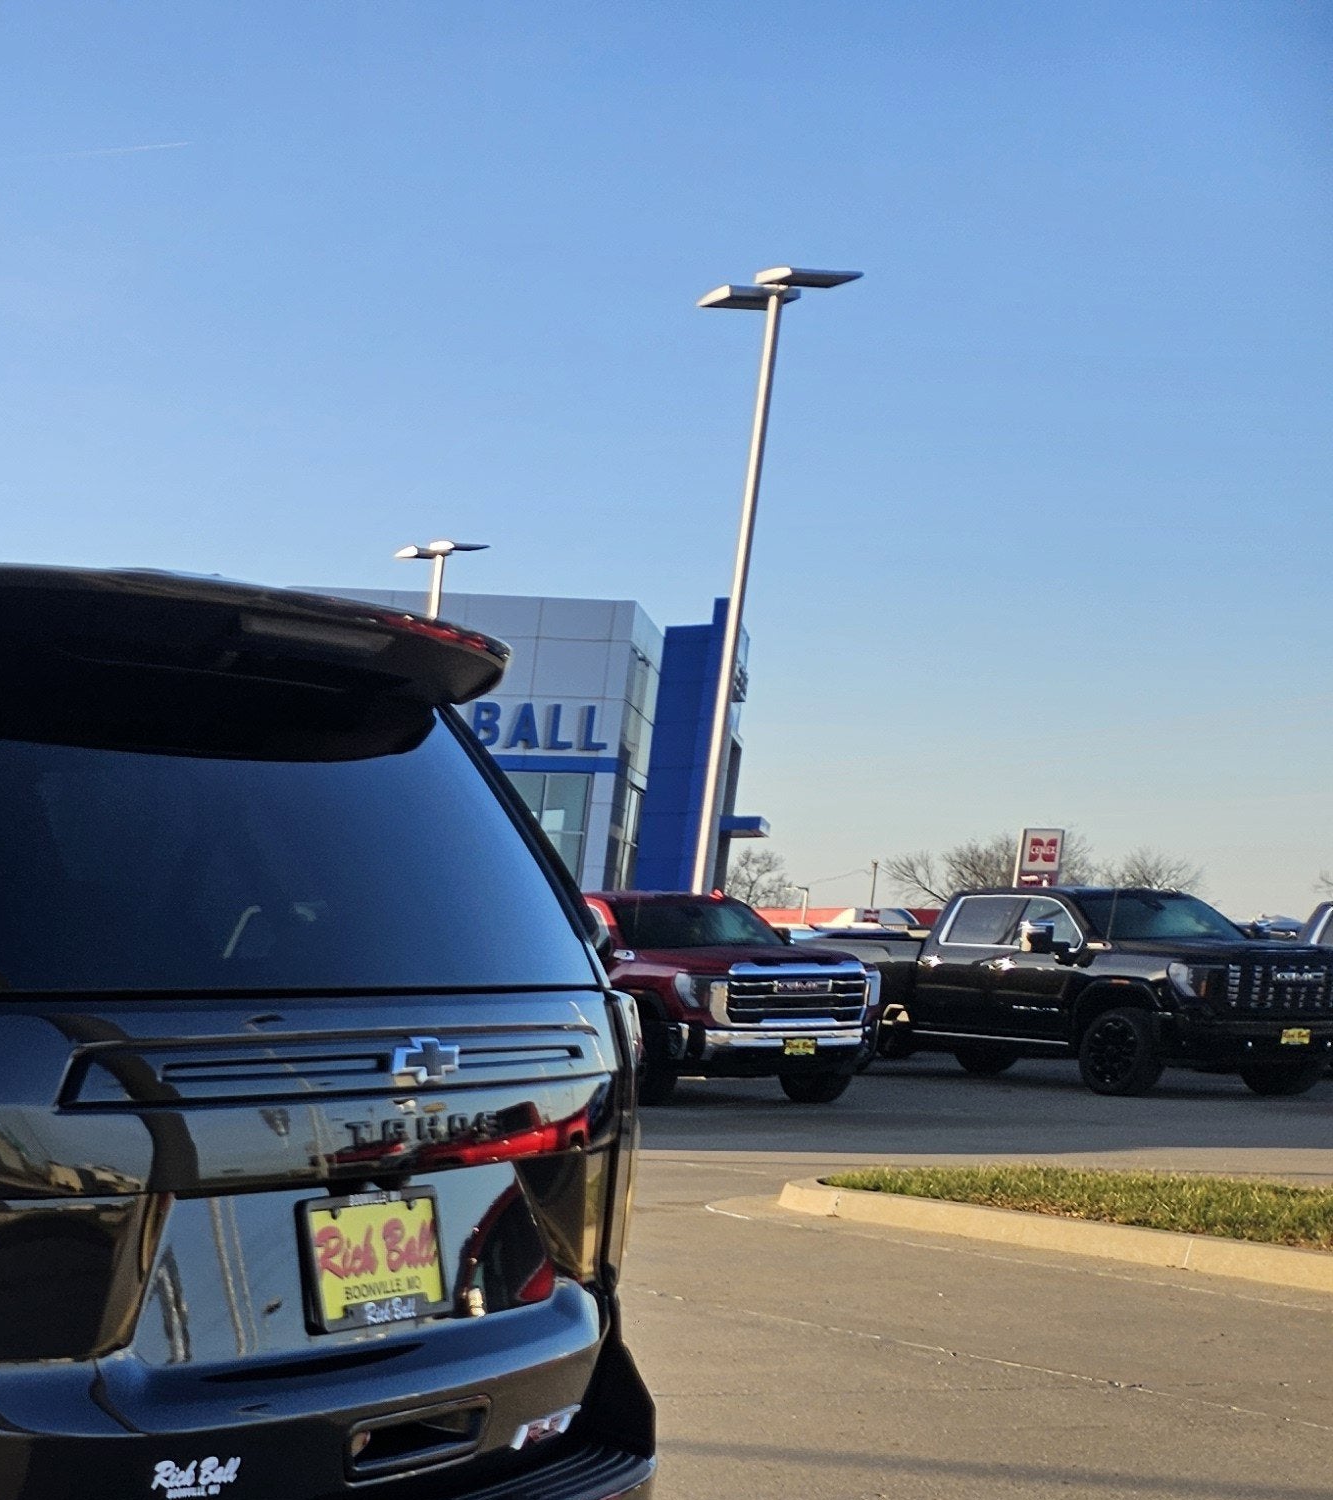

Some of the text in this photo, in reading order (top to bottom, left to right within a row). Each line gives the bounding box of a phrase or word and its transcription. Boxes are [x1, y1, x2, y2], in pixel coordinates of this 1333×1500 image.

[472, 701, 608, 750] BALL
[314, 1217, 439, 1280] Rick Ball
[406, 1275, 422, 1290] MO
[364, 1296, 417, 1324] Rick Ball
[151, 1456, 241, 1491] Rick Ball
